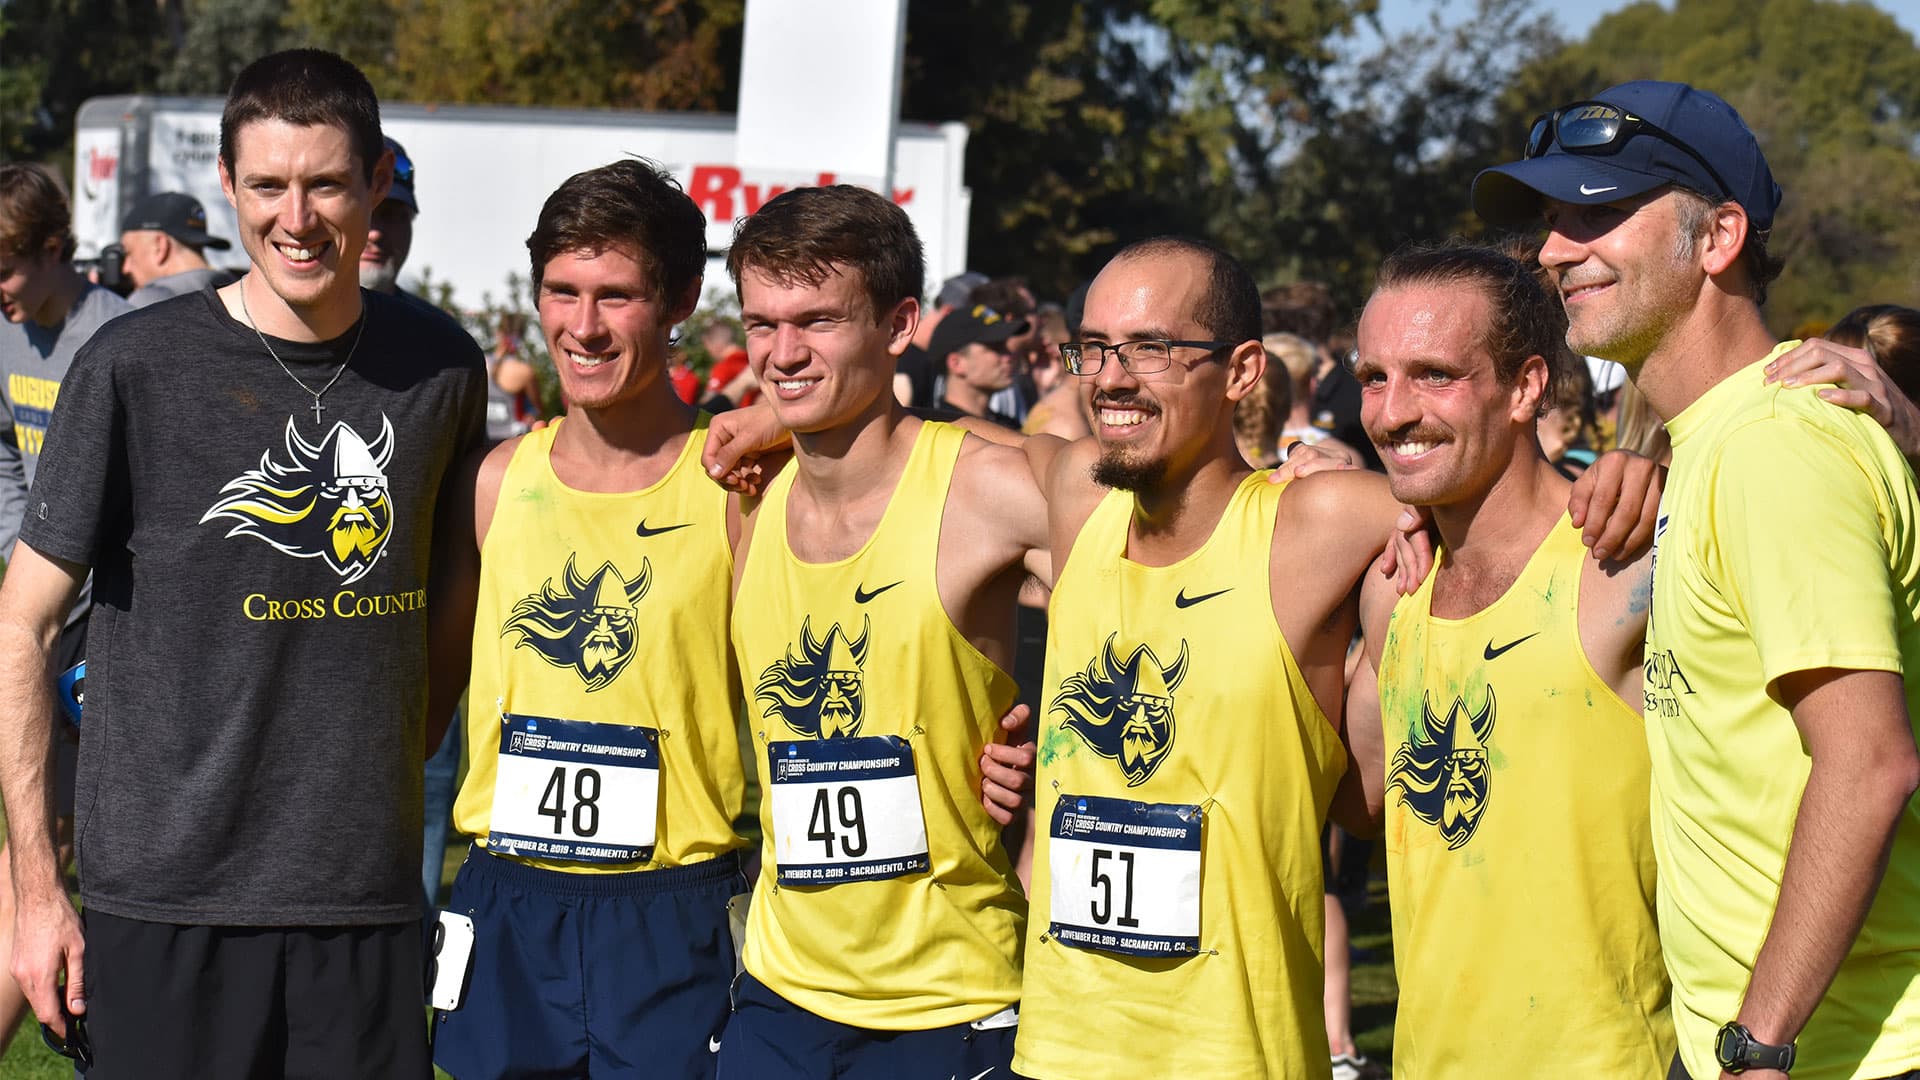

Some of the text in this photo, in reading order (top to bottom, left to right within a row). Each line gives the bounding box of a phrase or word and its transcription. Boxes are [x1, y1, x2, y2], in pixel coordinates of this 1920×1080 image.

[243, 588, 428, 621] CROSS COUNTR
[524, 738, 545, 749] CROSS
[546, 740, 581, 753] COUNTRY
[581, 743, 647, 758] CHAMPIONSHIPS
[788, 757, 900, 773] CROSS COUNTRY CHAMPIONSHIPS
[538, 766, 602, 838] 48
[808, 786, 868, 858] 49
[1075, 819, 1095, 830] CROSS
[1095, 822, 1124, 833] COUNTRY
[1123, 825, 1187, 839] CHAMPIONSHIPS
[500, 837, 538, 851] NOVEMBER
[538, 841, 549, 853] 23,
[550, 842, 570, 854] 2019
[575, 846, 630, 860] SACRAMENTO,
[812, 868, 825, 879] 23,
[825, 867, 844, 878] 2019
[907, 859, 918, 870] CA
[1091, 848, 1139, 928] 51
[1061, 929, 1091, 943] NOVEMBER
[1102, 934, 1116, 946] 2019
[1120, 937, 1172, 952] SACRAMENTO,
[1174, 942, 1187, 952] CA
